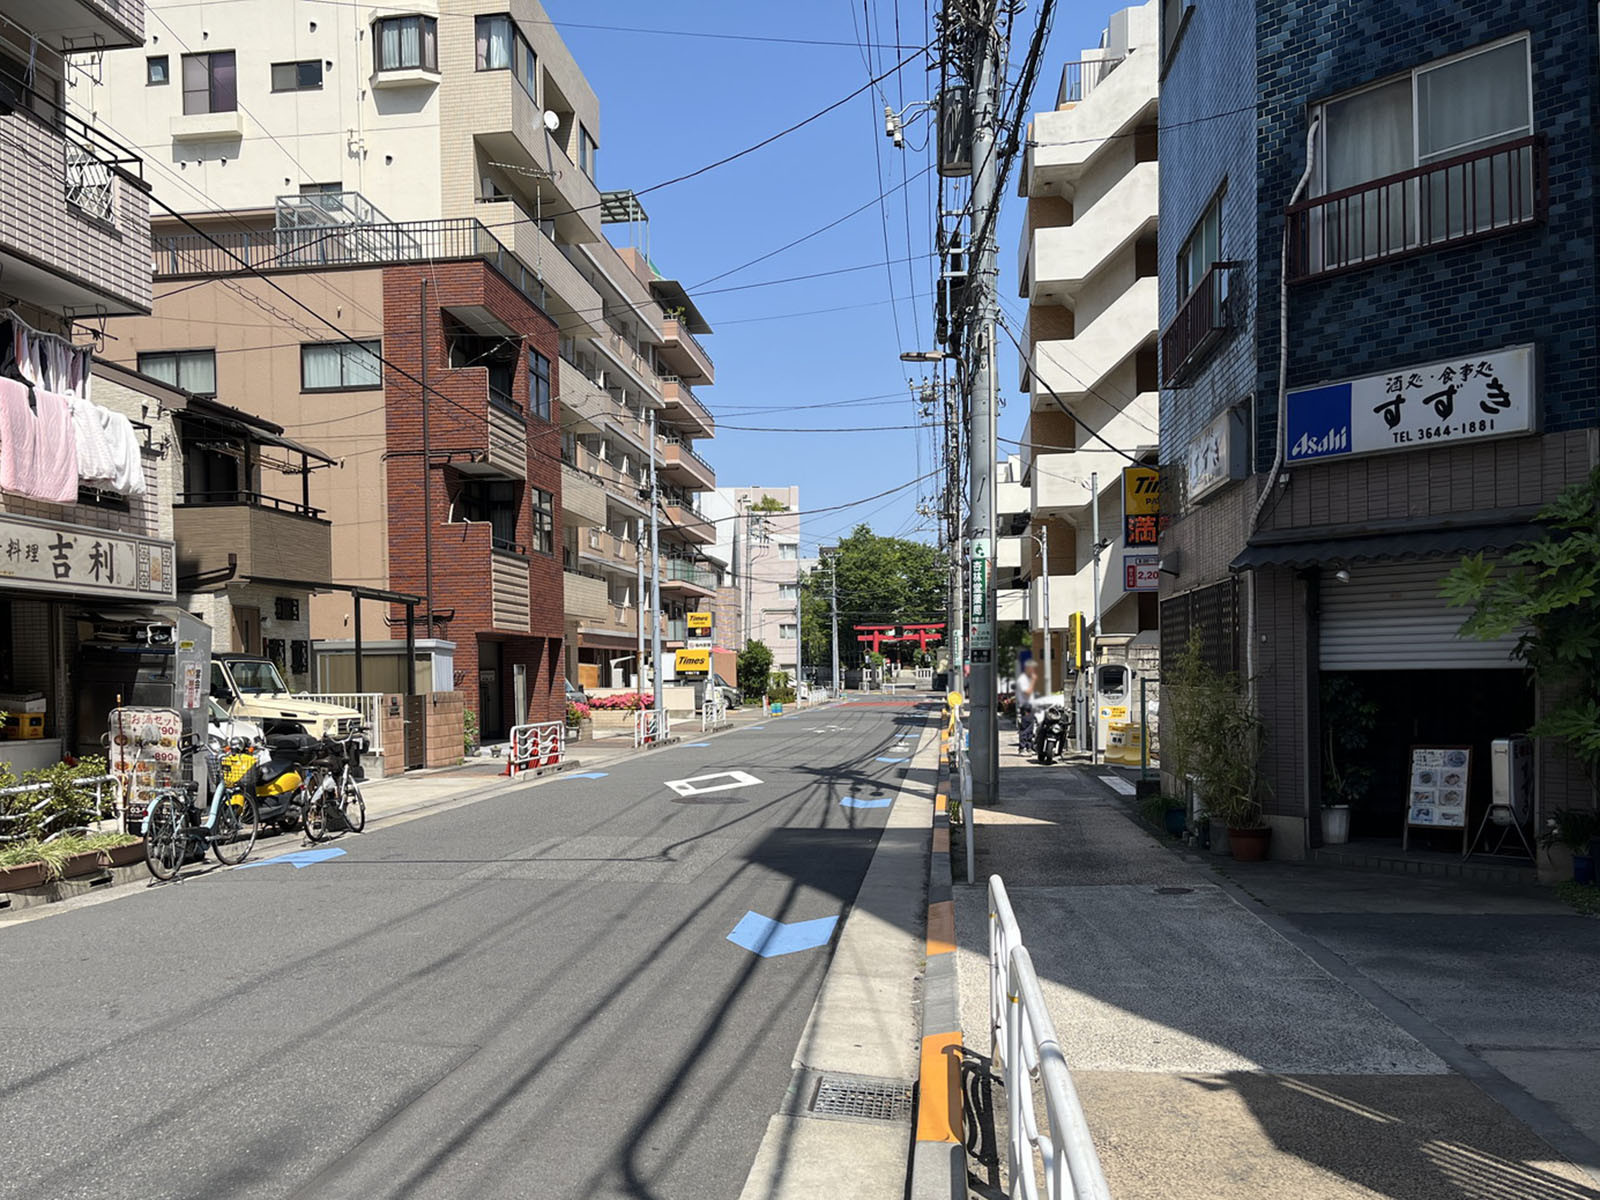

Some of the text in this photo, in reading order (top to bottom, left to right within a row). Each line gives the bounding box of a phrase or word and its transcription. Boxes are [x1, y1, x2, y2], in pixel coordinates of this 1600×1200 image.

[1373, 377, 1511, 429] すずき
[1291, 426, 1347, 457] Asahi
[1392, 418, 1495, 444] TEL 3644-1881
[48, 533, 114, 584] 吉利
[679, 656, 705, 665] Times
